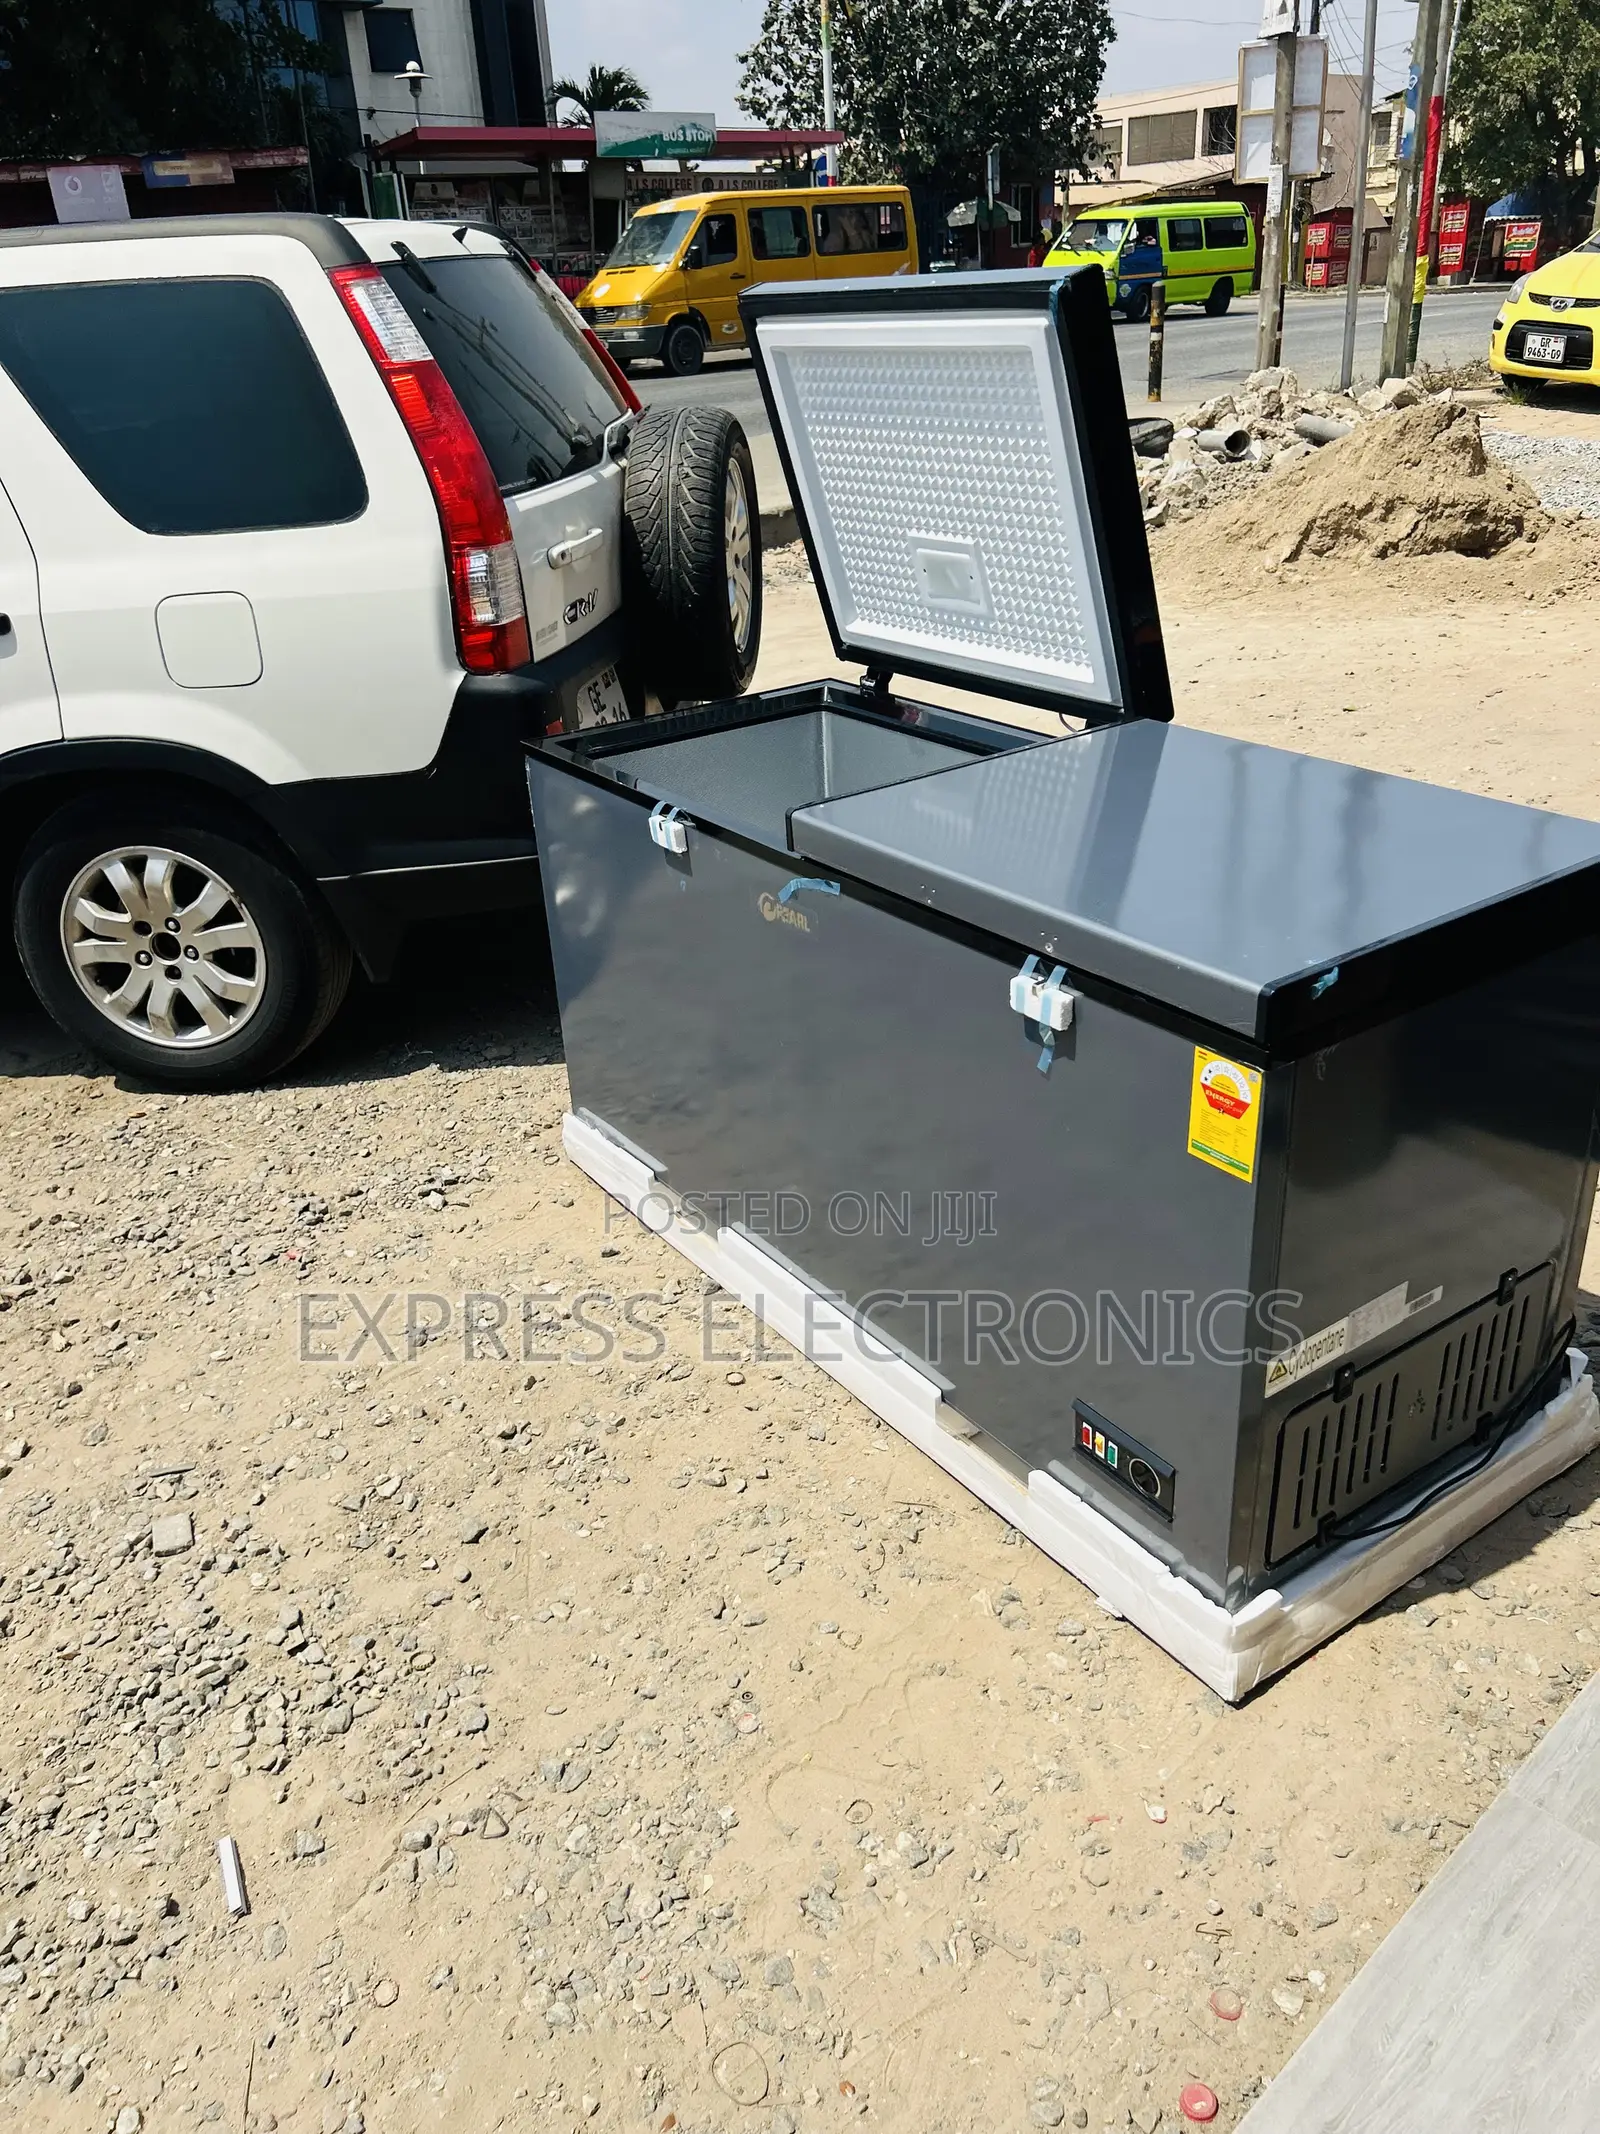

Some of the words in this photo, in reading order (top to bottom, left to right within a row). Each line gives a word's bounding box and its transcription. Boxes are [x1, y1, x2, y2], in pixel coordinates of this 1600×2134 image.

[662, 128, 685, 142] BUS
[650, 177, 693, 191] COLLEGE
[740, 178, 779, 191] COLLEGE
[1540, 337, 1552, 348] GR
[1527, 346, 1562, 360] 9463-09
[587, 680, 607, 716] GE
